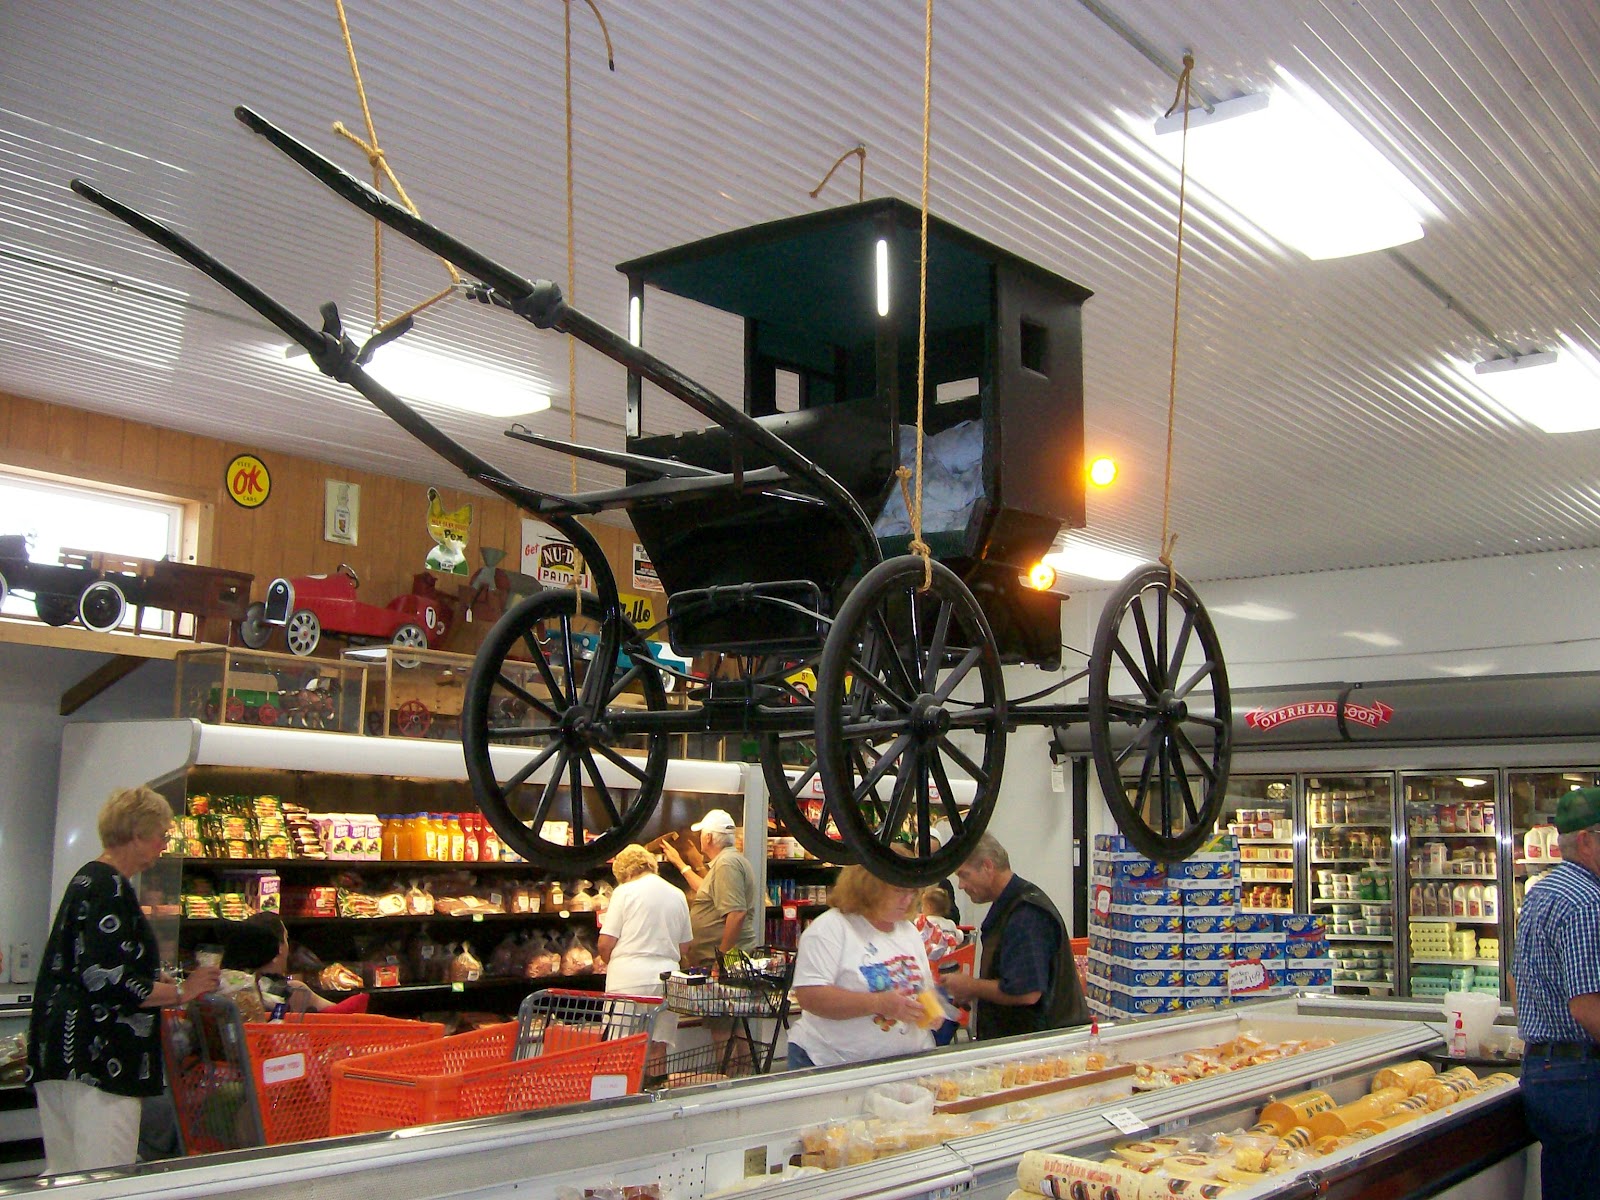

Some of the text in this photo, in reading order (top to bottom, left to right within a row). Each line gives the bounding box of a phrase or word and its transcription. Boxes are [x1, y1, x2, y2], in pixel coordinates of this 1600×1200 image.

[233, 465, 264, 495] OK
[443, 529, 463, 542] Pex
[524, 543, 540, 556] Get
[542, 547, 575, 565] NU-D
[1261, 703, 1336, 728] OVERHEAD
